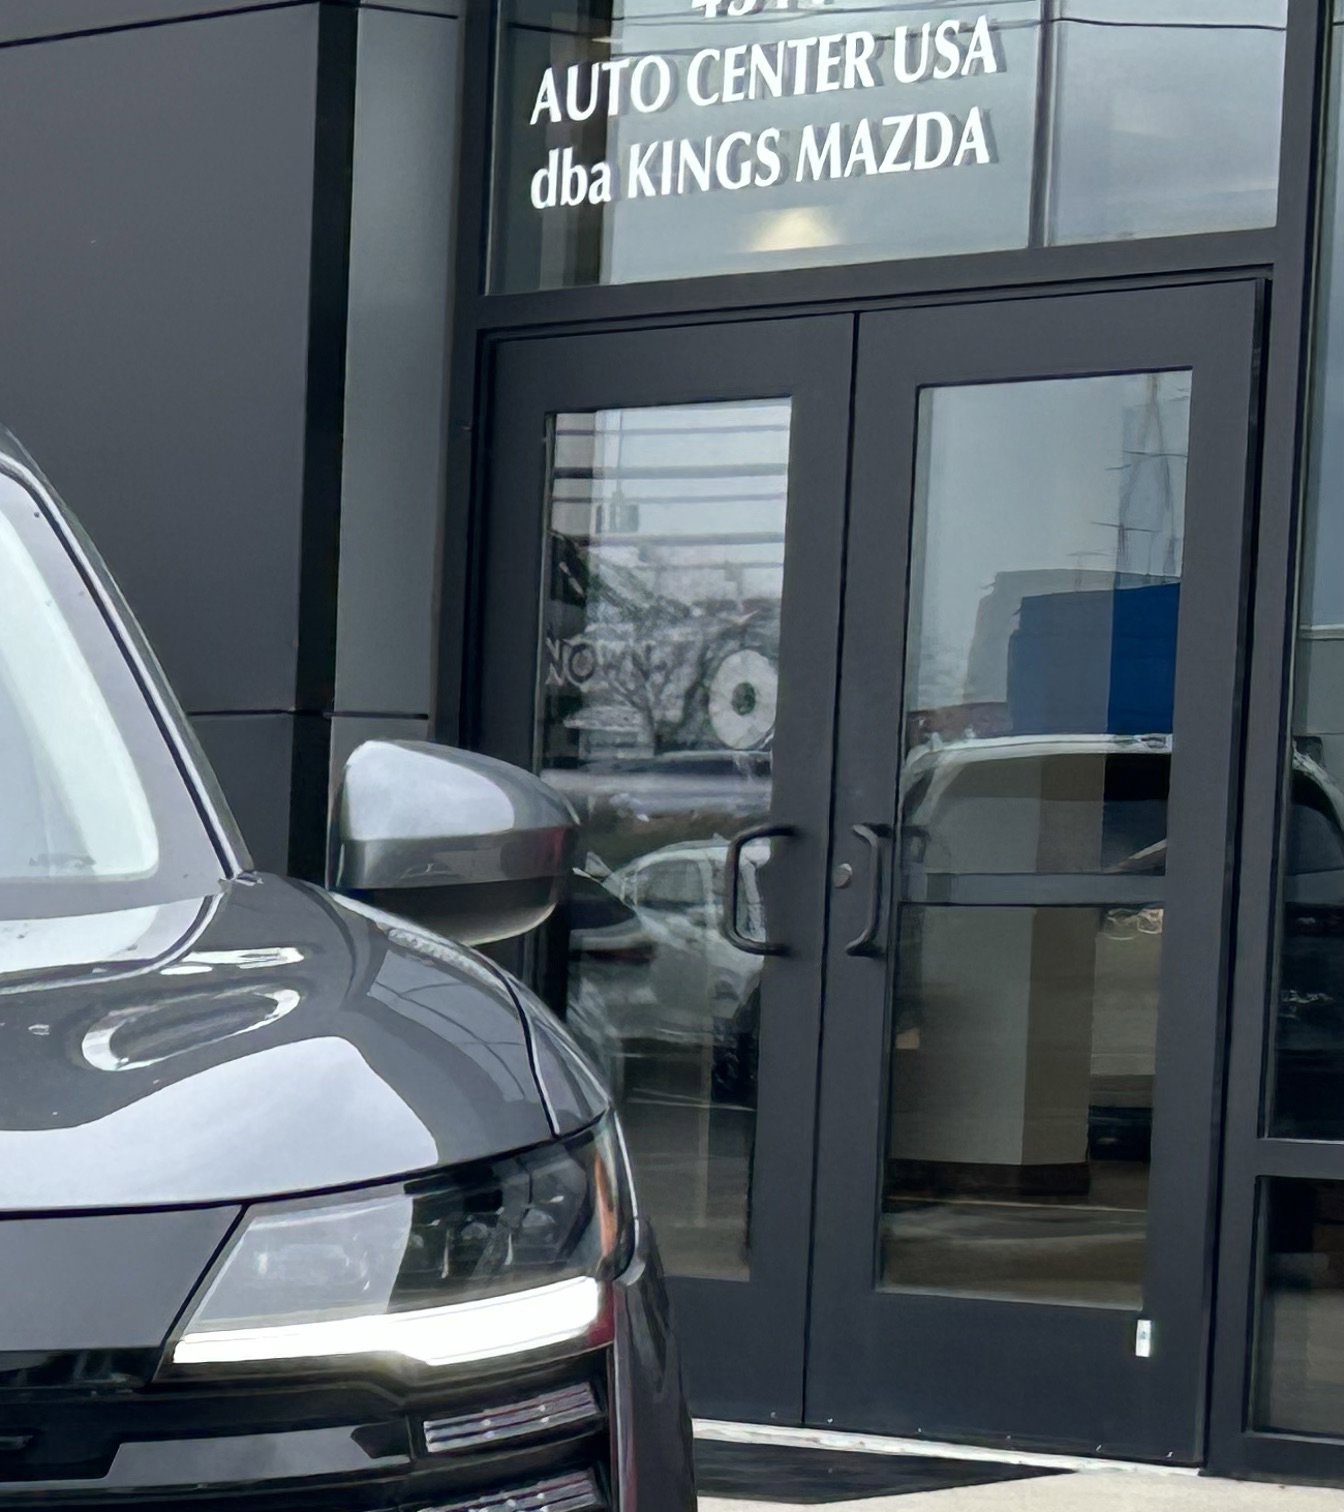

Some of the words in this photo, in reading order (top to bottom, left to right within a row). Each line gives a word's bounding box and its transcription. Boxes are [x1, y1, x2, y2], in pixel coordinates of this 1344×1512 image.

[530, 56, 671, 125] AUTO
[687, 30, 875, 107] CENTER
[894, 15, 999, 84] USA
[530, 146, 612, 210] dba
[627, 127, 782, 199] KINGS
[795, 106, 991, 182] MAZDA
